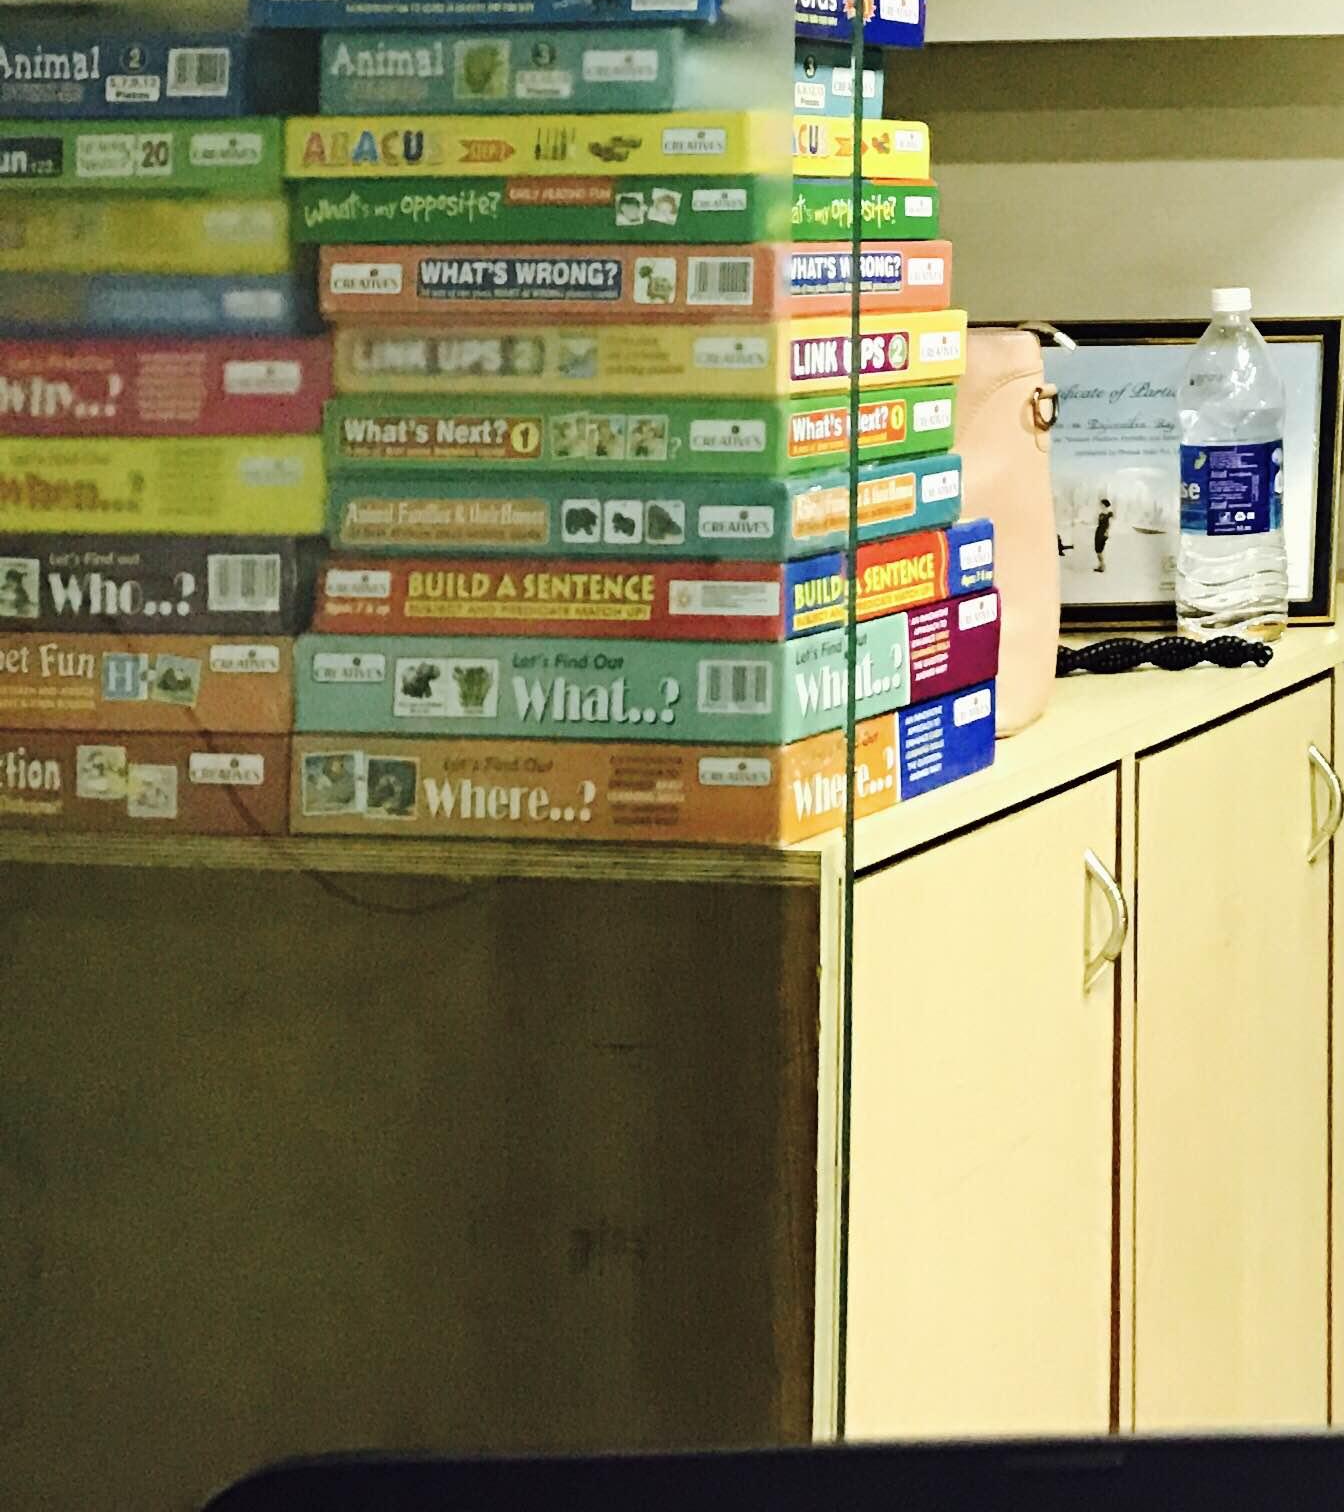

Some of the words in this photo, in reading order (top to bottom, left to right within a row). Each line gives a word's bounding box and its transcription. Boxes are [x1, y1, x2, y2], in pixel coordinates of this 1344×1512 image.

[0, 45, 101, 81] Animal
[330, 41, 445, 78] Animal
[141, 140, 169, 169] 20
[304, 190, 370, 228] What's
[400, 190, 502, 223] opposite?
[421, 260, 509, 286] WHAT'S
[515, 260, 619, 287] WRONG?
[793, 340, 838, 376] LINK
[343, 419, 429, 444] What's
[436, 419, 508, 445] Next?
[520, 426, 530, 449] 1
[792, 414, 842, 443] What's
[407, 571, 491, 598] BUILD
[496, 572, 517, 598] A
[522, 572, 656, 602] SENTENCE
[794, 575, 842, 611] BUILD
[863, 552, 936, 593] SENTENCE
[0, 646, 30, 674] et
[39, 643, 96, 680] Fun
[107, 660, 133, 693] H
[554, 653, 589, 669] Find
[0, 746, 61, 790] tion
